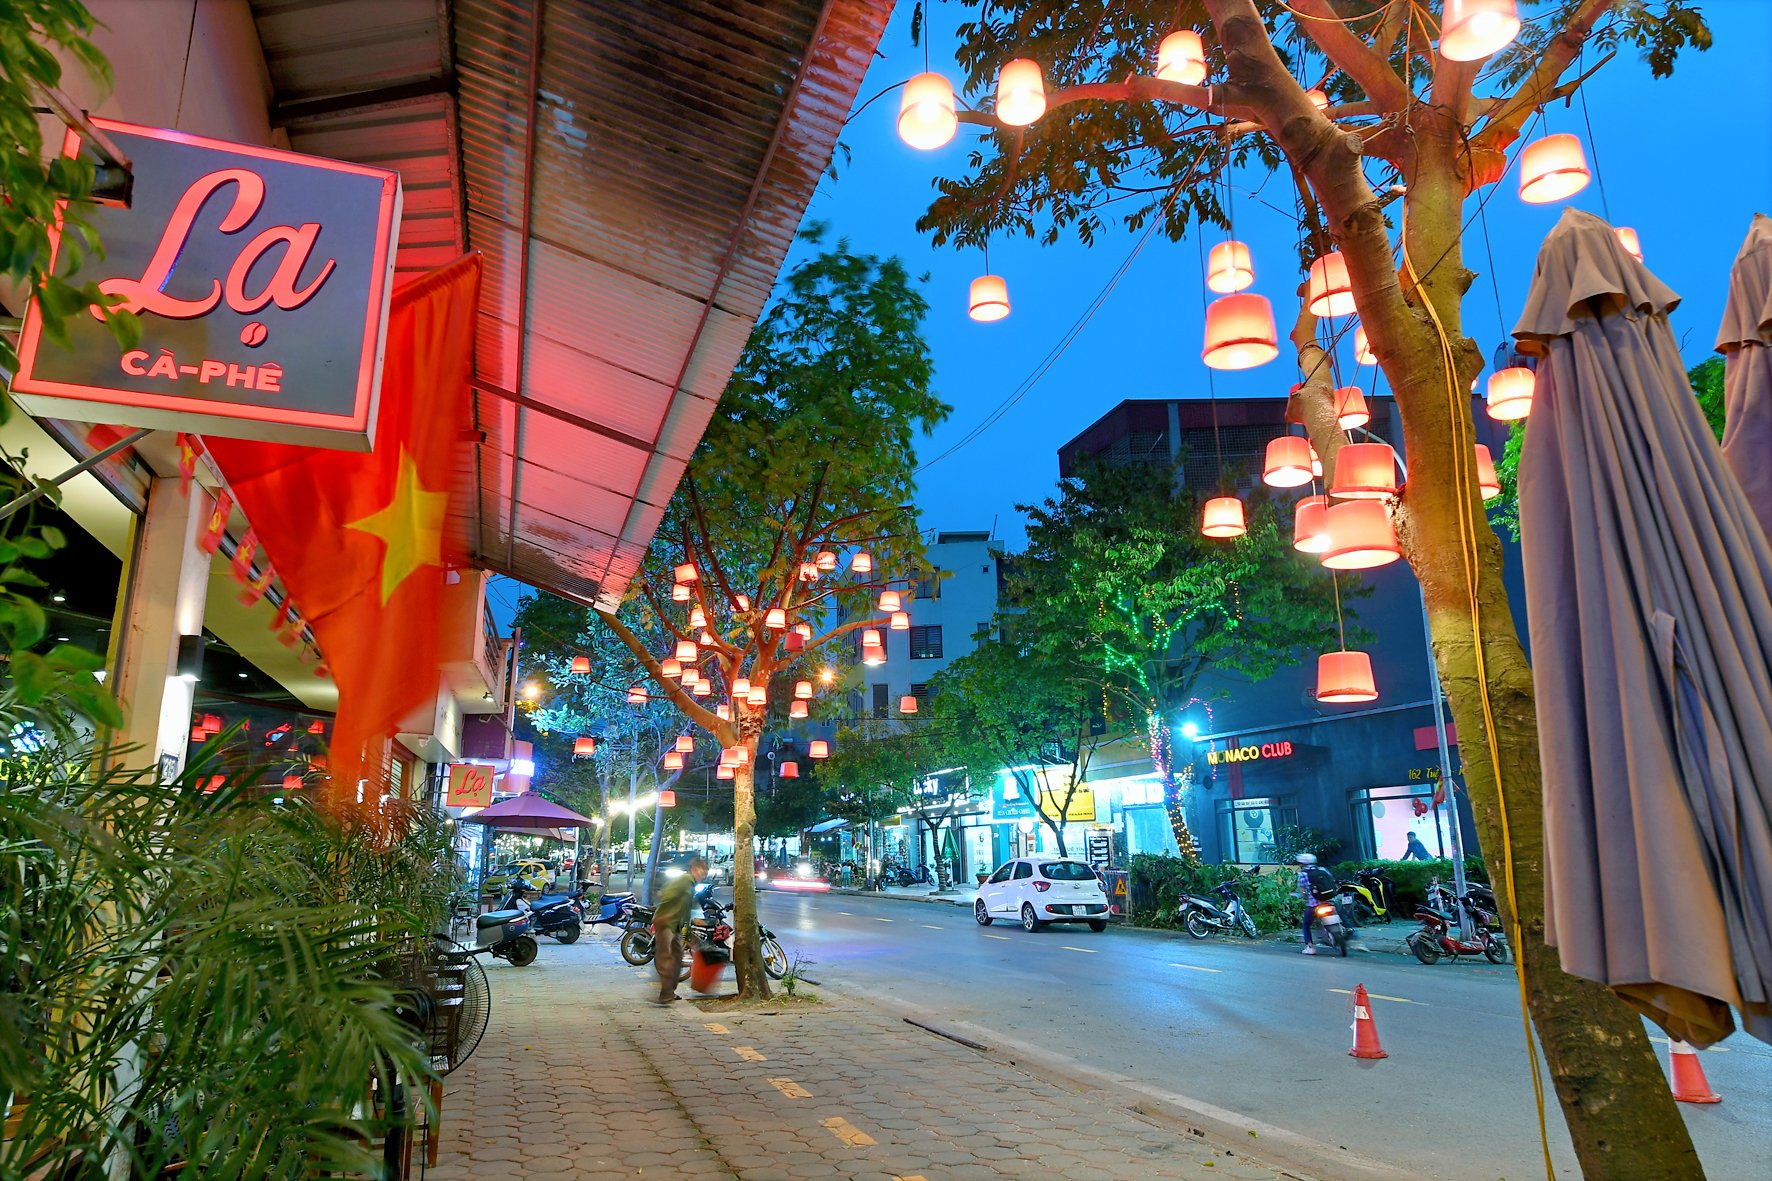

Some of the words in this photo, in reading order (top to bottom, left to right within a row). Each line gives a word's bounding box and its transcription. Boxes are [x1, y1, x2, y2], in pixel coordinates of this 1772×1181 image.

[121, 348, 283, 392] CÀ-PHÊ
[1207, 746, 1260, 765] MONACO
[1261, 741, 1292, 758] CLUB
[1408, 769, 1421, 780] 162
